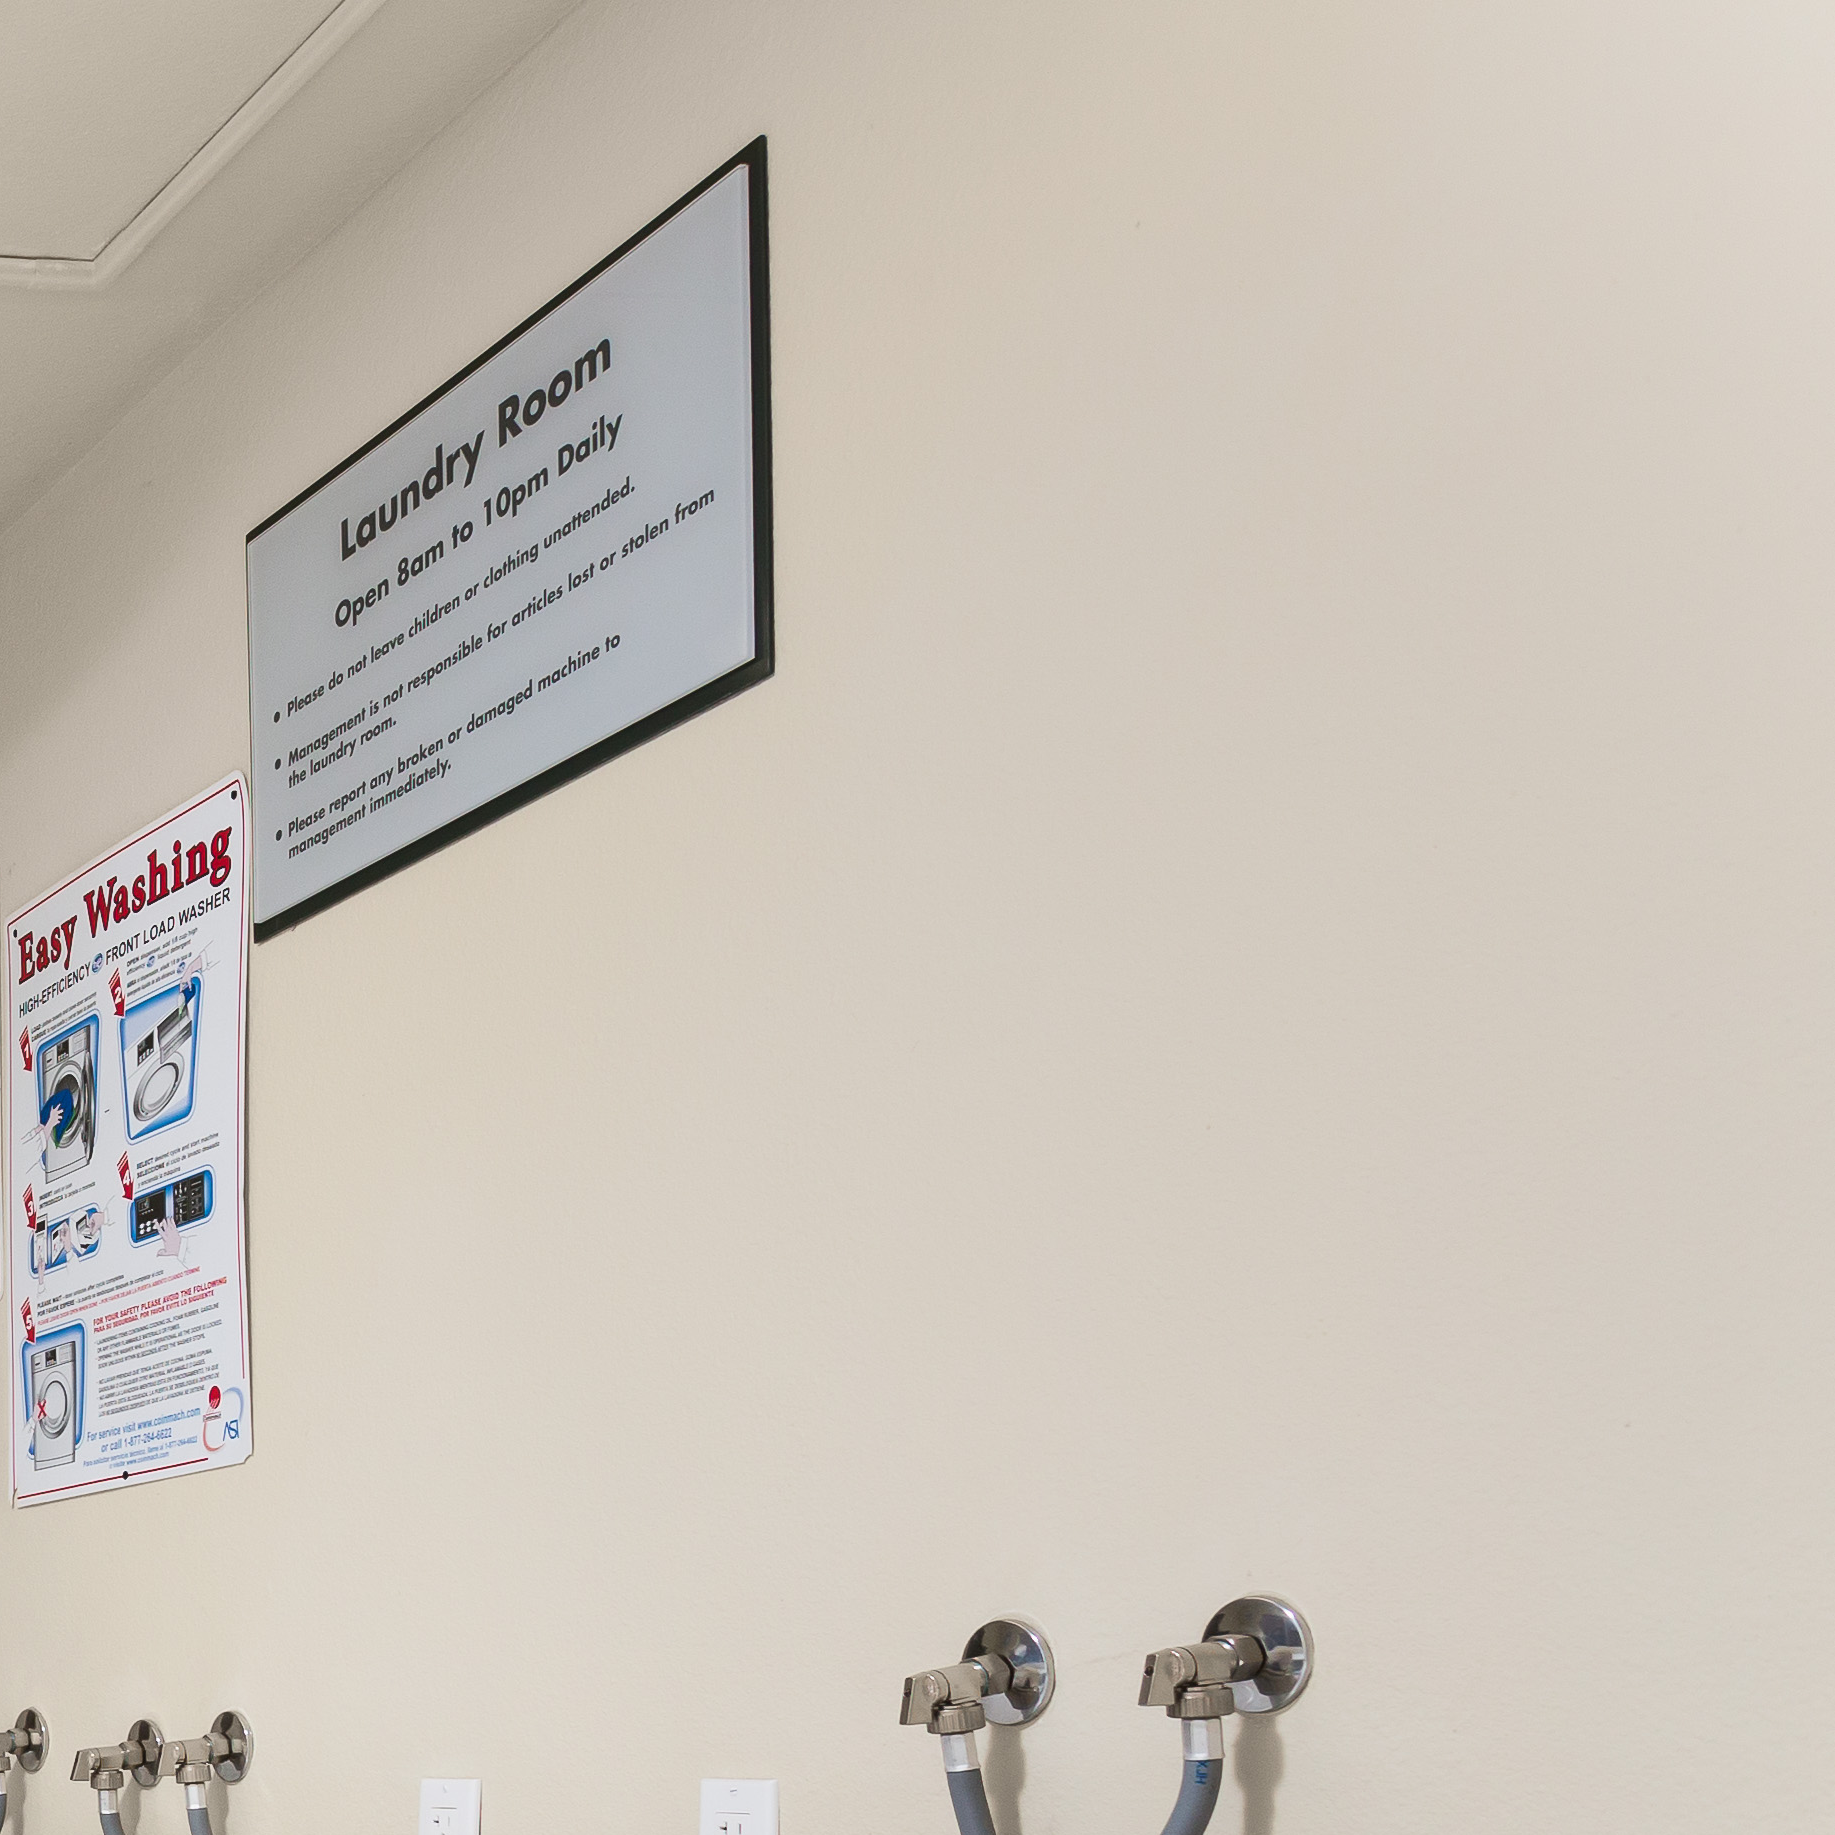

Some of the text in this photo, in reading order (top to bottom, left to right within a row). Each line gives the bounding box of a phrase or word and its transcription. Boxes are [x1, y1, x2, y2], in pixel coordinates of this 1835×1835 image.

[341, 338, 610, 561] Laundry Room
[334, 413, 622, 627] Open 8am to 10pm Daily
[287, 475, 635, 717] Please do not leave children or clothing unattended.
[288, 489, 714, 766] Management is not responsible for articles lost or stolen from
[288, 634, 620, 837] Please report any broken or damaged machine to
[288, 716, 396, 788] the laundry room.
[288, 758, 451, 859] management immediately.
[17, 914, 77, 985] Easy
[82, 826, 232, 938] Washing
[19, 961, 90, 1018] HIGH-EFFICIENCY
[105, 932, 140, 965] FRONT
[143, 915, 175, 944] LOAD
[178, 886, 230, 926] WASHER
[114, 984, 121, 1005] 2
[26, 1198, 34, 1218] 3
[122, 1167, 131, 1188] 4
[25, 1313, 32, 1331] 5
[93, 1316, 103, 1326] FOR
[104, 1311, 119, 1322] YOUR
[119, 1305, 139, 1317] SAFETY
[140, 1297, 161, 1310] PLEASE
[193, 1276, 227, 1293] FOLLOWING
[86, 1407, 200, 1441] For service visit www.coinmach.com
[100, 1443, 108, 1452] or
[109, 1438, 122, 1450] call
